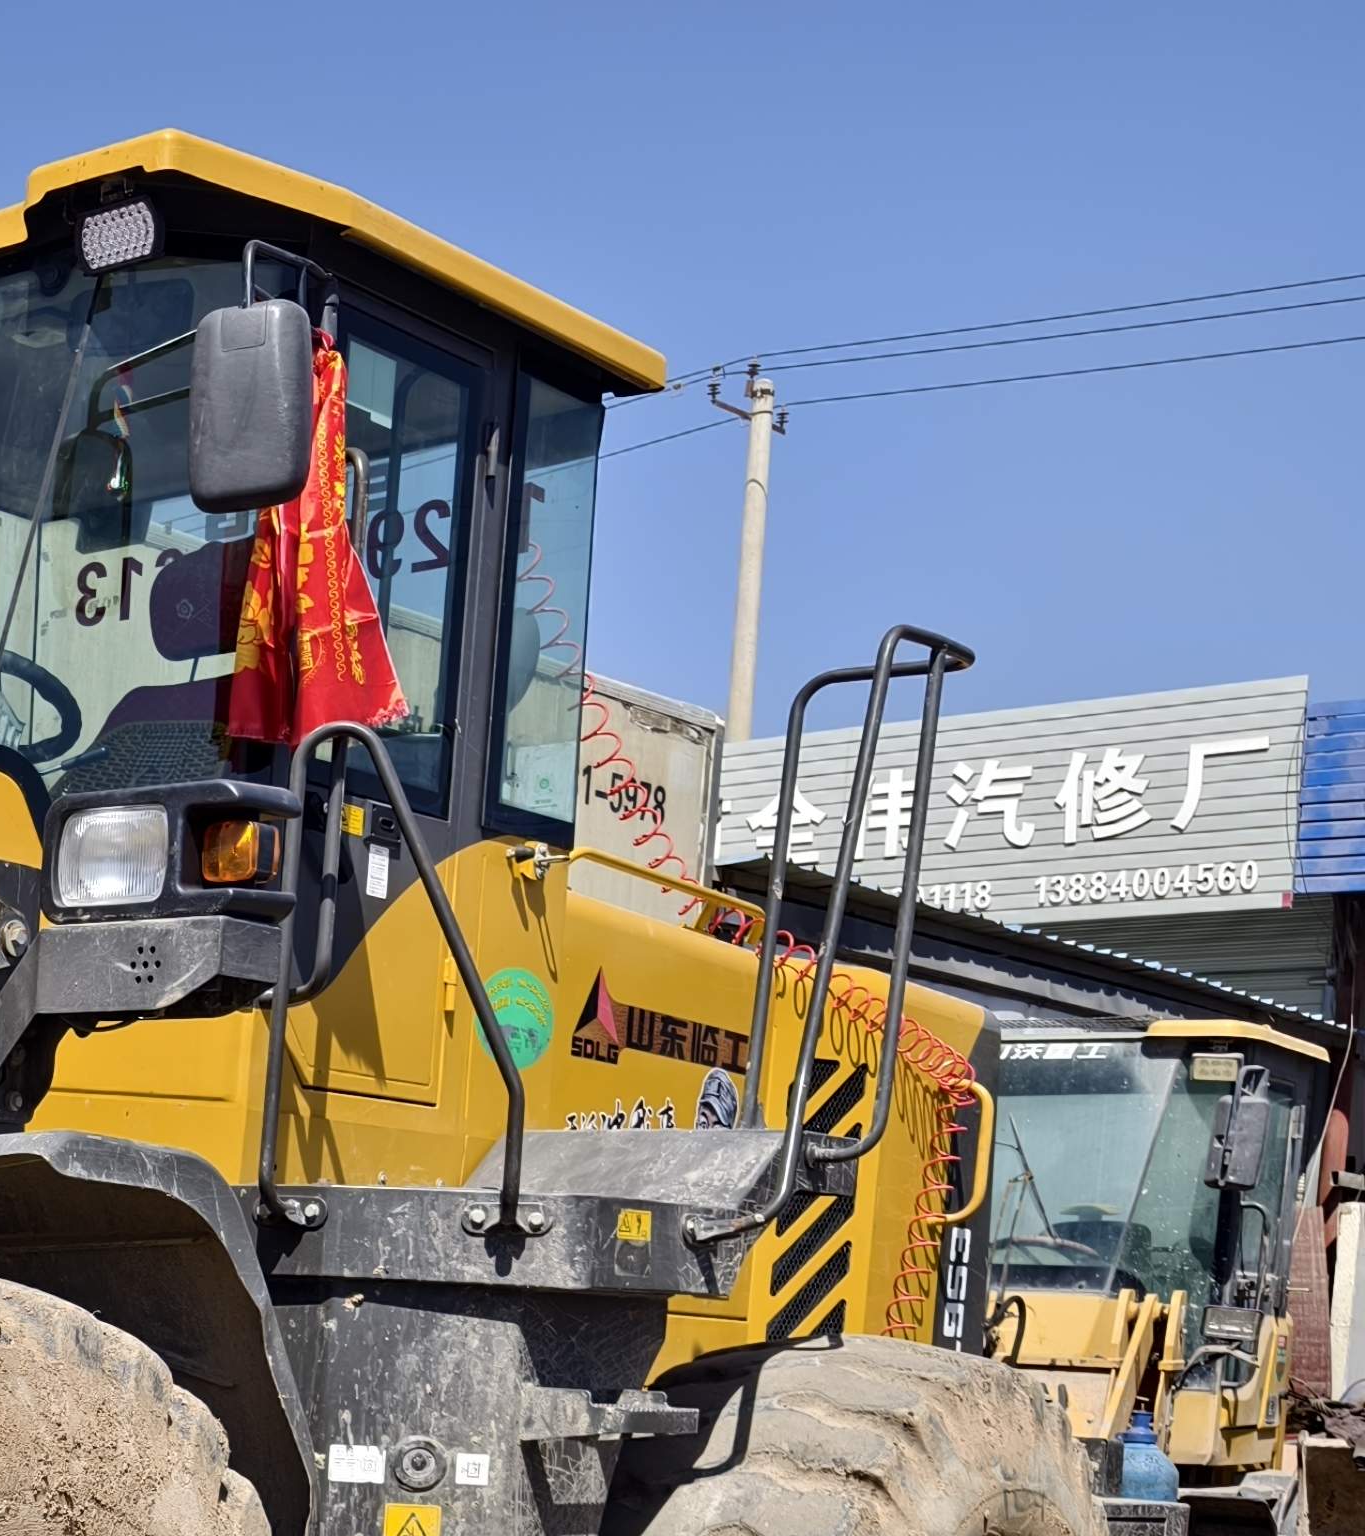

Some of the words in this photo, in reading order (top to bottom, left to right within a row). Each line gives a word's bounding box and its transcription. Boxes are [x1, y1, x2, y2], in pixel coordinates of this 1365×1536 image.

[713, 736, 1270, 864] 全伟汽修厂
[1034, 860, 1259, 908] 13884004560
[570, 1035, 619, 1065] SDLG
[625, 1005, 750, 1075] 山东临工
[1000, 1042, 1112, 1060] 沃重工
[943, 1226, 972, 1352] 953
